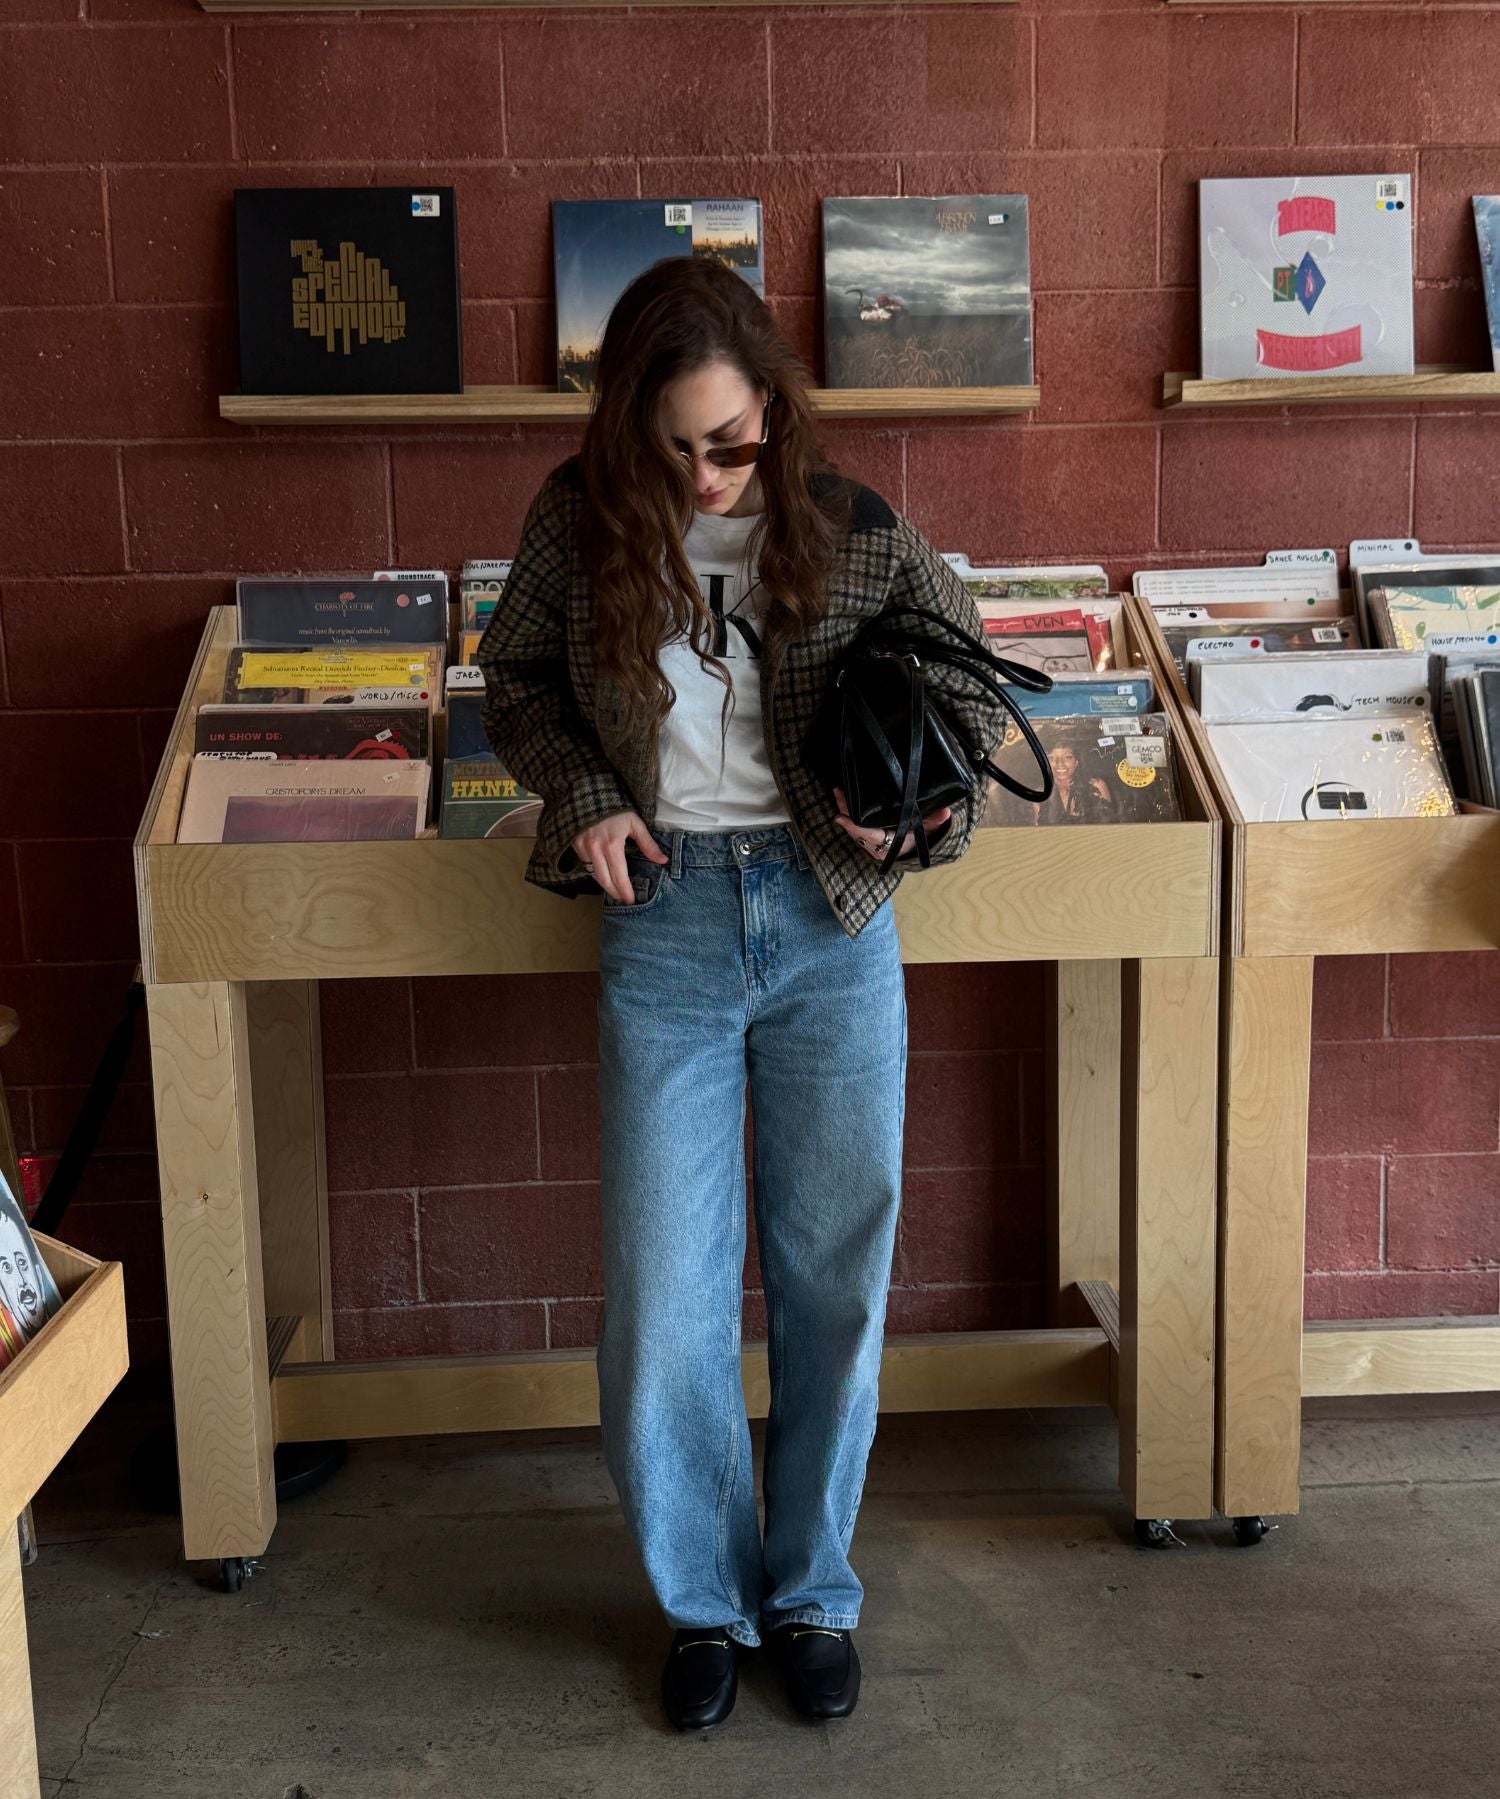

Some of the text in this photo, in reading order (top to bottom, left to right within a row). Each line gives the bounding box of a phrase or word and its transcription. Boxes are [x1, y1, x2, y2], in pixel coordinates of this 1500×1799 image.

[706, 203, 744, 212] RAHAAN
[1357, 544, 1395, 552] MINIMAL
[1023, 616, 1065, 630] EVEN
[1198, 641, 1234, 650] ELECTRO
[455, 671, 480, 680] JAZZ
[1355, 695, 1415, 705] TECH HOUSE
[210, 731, 283, 742] UN SHOW DE:
[1131, 745, 1162, 753] GEMCO
[329, 787, 366, 795] DREAM
[451, 780, 519, 798] HANK
